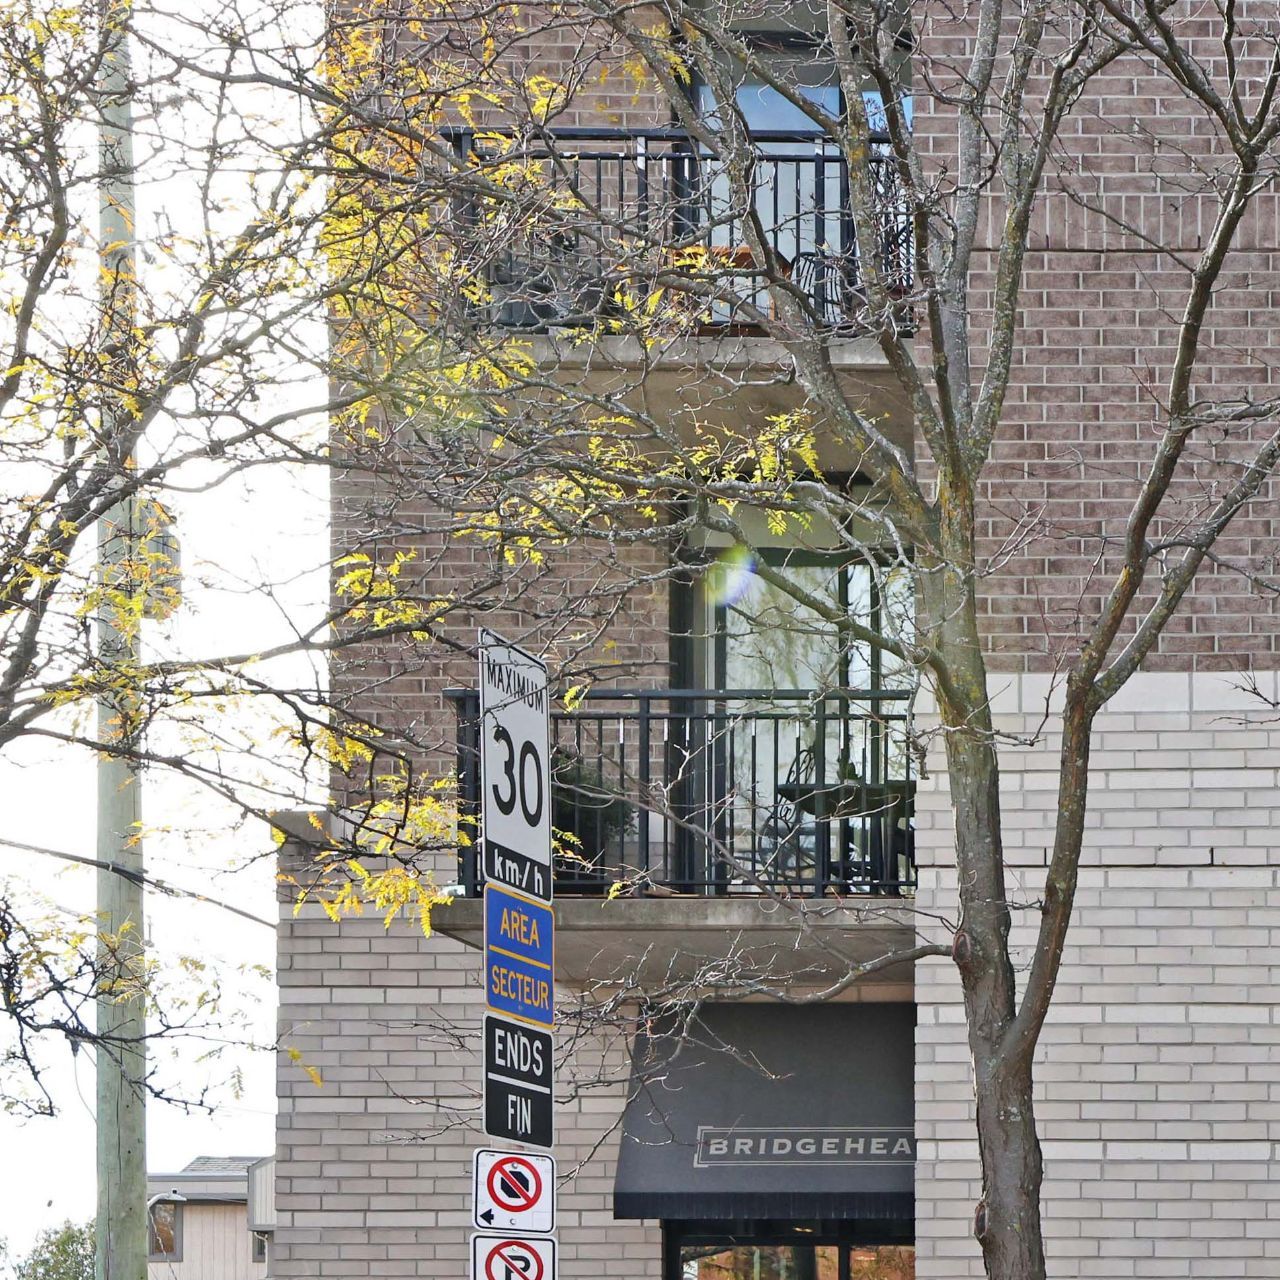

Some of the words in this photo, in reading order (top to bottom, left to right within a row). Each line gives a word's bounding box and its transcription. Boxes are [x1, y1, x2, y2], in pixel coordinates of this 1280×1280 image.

[487, 655, 544, 715] MAXIMUM
[492, 725, 543, 828] 30
[494, 848, 544, 896] km/h
[500, 907, 540, 949] AREA
[491, 964, 549, 1011] SECTEUR
[494, 1028, 543, 1077] ENDS
[507, 1093, 532, 1135] FIN
[709, 1138, 912, 1155] BRIDGEHEA
